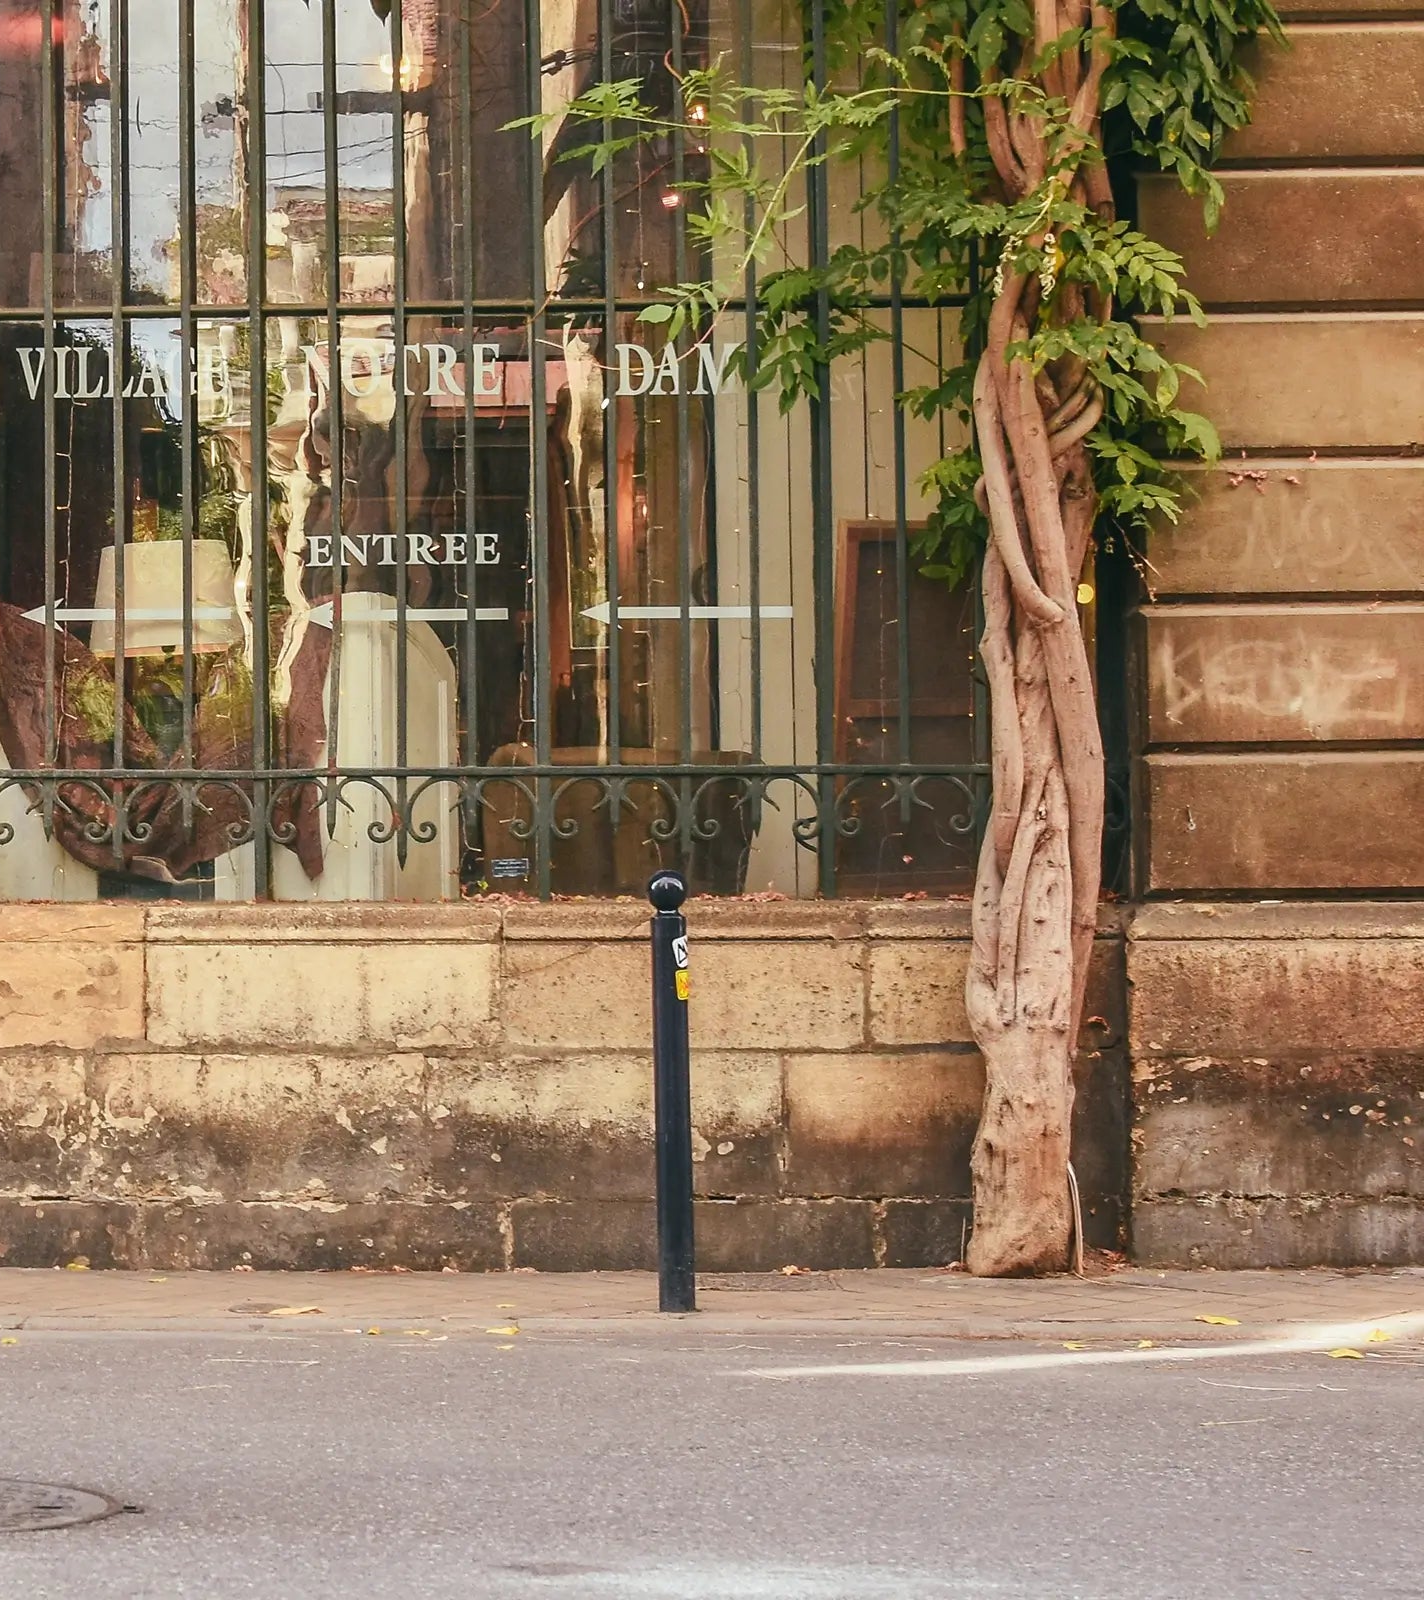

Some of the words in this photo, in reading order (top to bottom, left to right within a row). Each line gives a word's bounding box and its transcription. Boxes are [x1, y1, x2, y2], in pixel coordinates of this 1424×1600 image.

[299, 343, 502, 397] NOTRE
[615, 342, 779, 396] DAM
[305, 533, 501, 567] ENTREE
